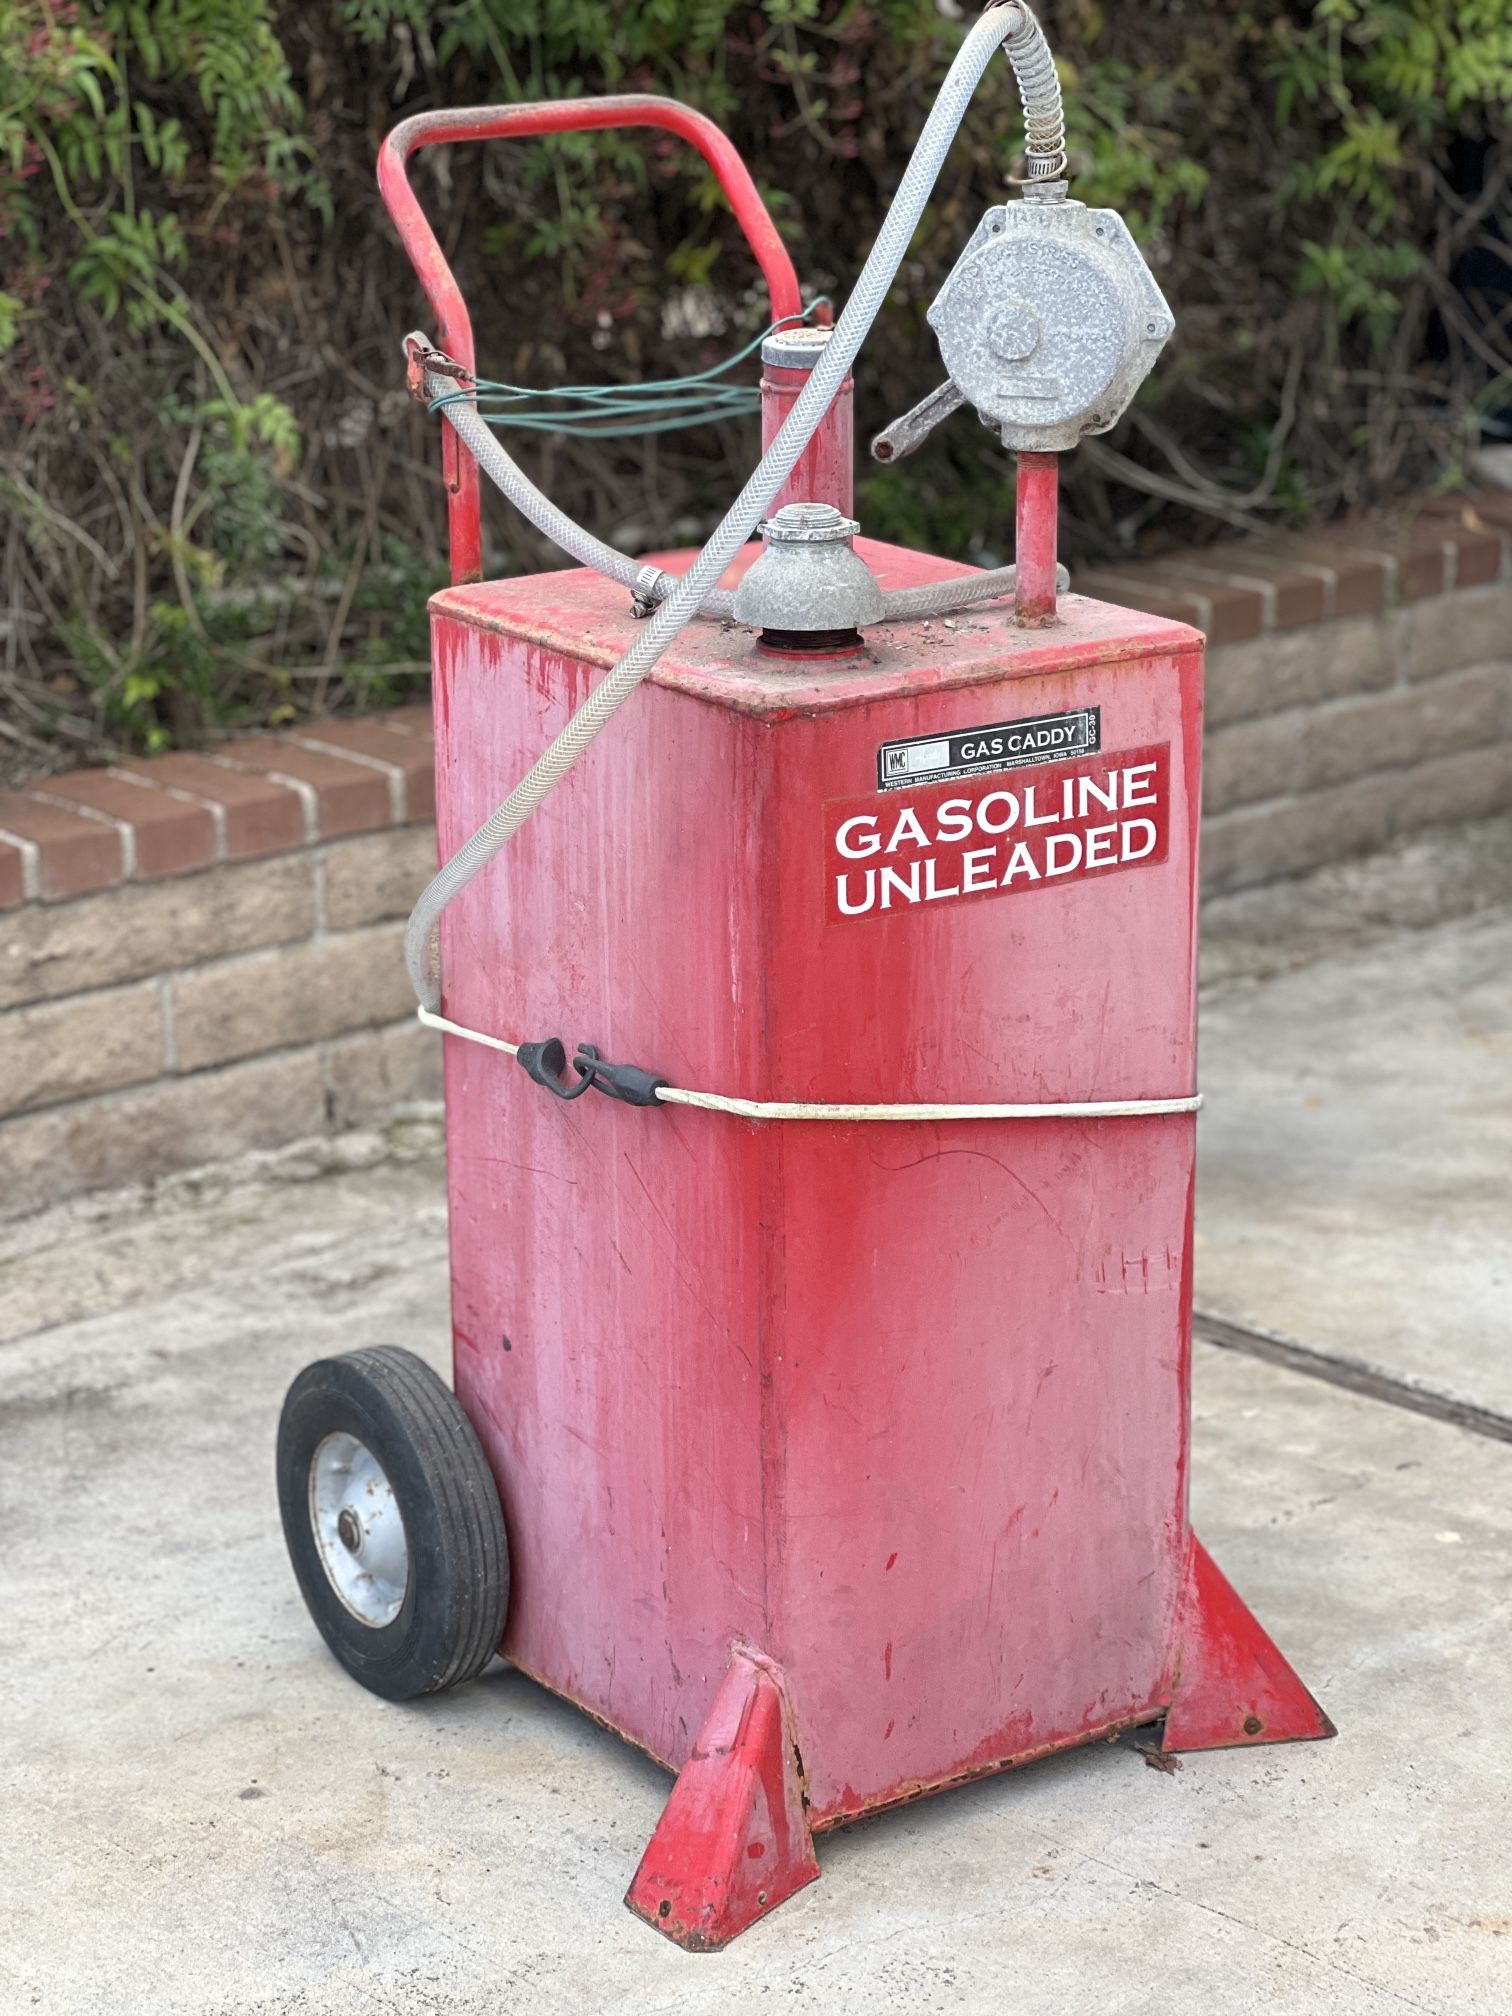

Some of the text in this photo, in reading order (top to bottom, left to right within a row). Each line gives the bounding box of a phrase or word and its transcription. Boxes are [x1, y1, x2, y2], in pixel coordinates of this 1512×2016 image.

[961, 738, 1003, 760] GAS
[1008, 725, 1076, 752] CADDY
[1088, 714, 1097, 744] GC-30
[885, 778, 912, 788] WESTERN
[914, 769, 961, 783] MANUFACTURING
[963, 763, 1002, 775] CORPORATION
[1053, 750, 1067, 759] IOWA
[1070, 748, 1085, 756] 50158
[889, 751, 906, 771] WMC
[835, 762, 1157, 858] GASOLINE
[836, 818, 1156, 915] UNLEADED
